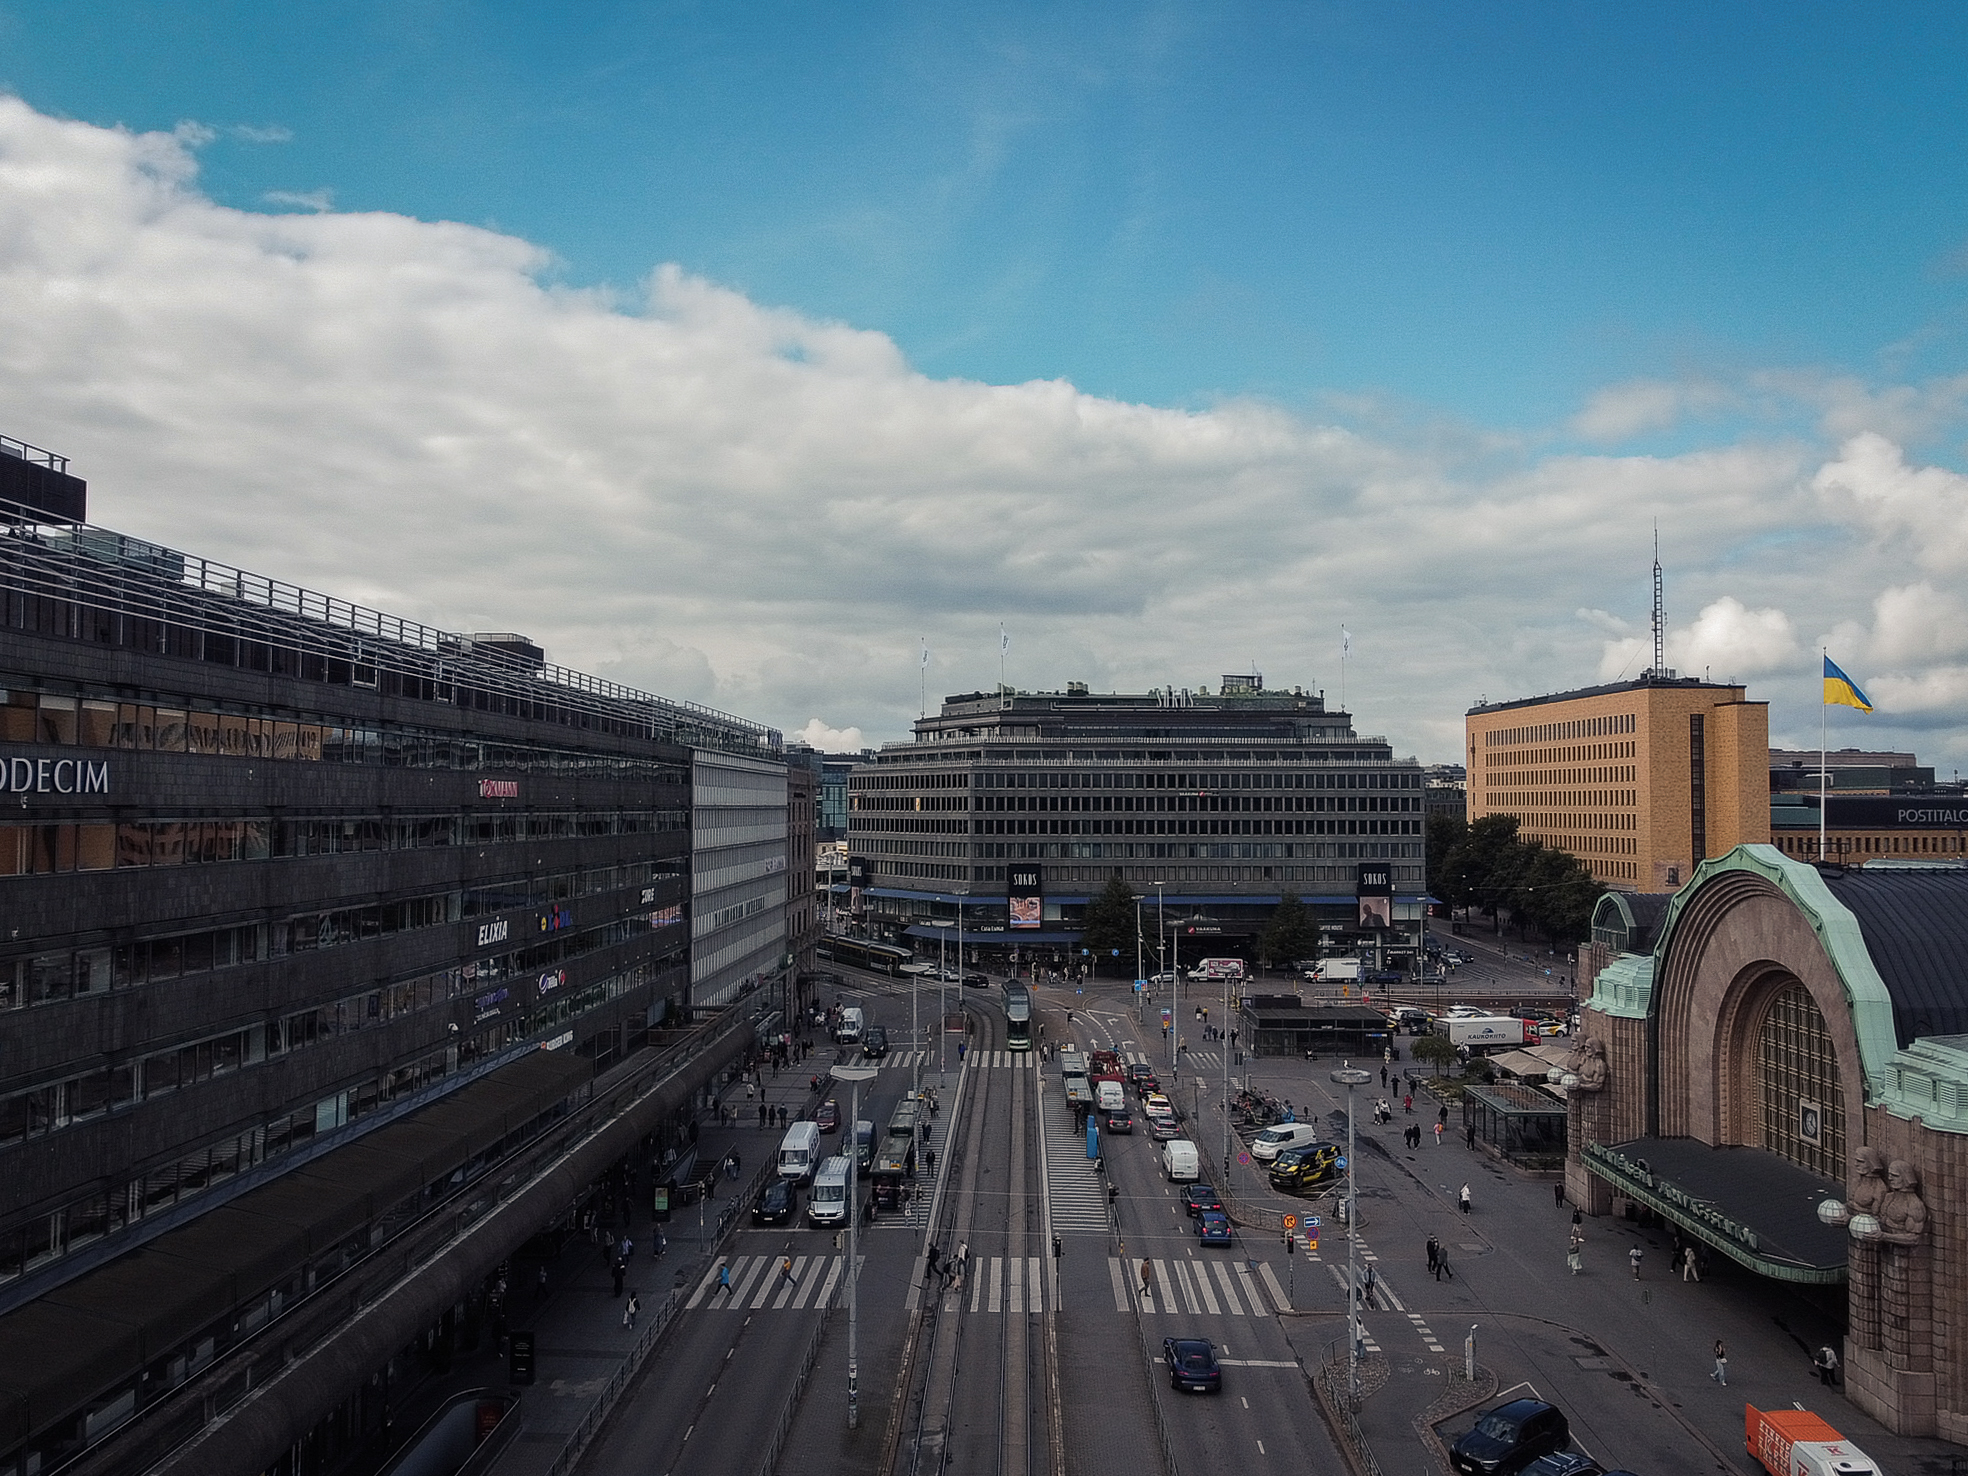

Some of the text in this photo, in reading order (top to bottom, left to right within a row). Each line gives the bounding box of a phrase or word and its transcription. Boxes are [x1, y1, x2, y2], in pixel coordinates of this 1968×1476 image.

[1013, 873, 1037, 886] SOKOS
[1363, 873, 1387, 885] SOKOS
[478, 920, 508, 946] ELIXIA
